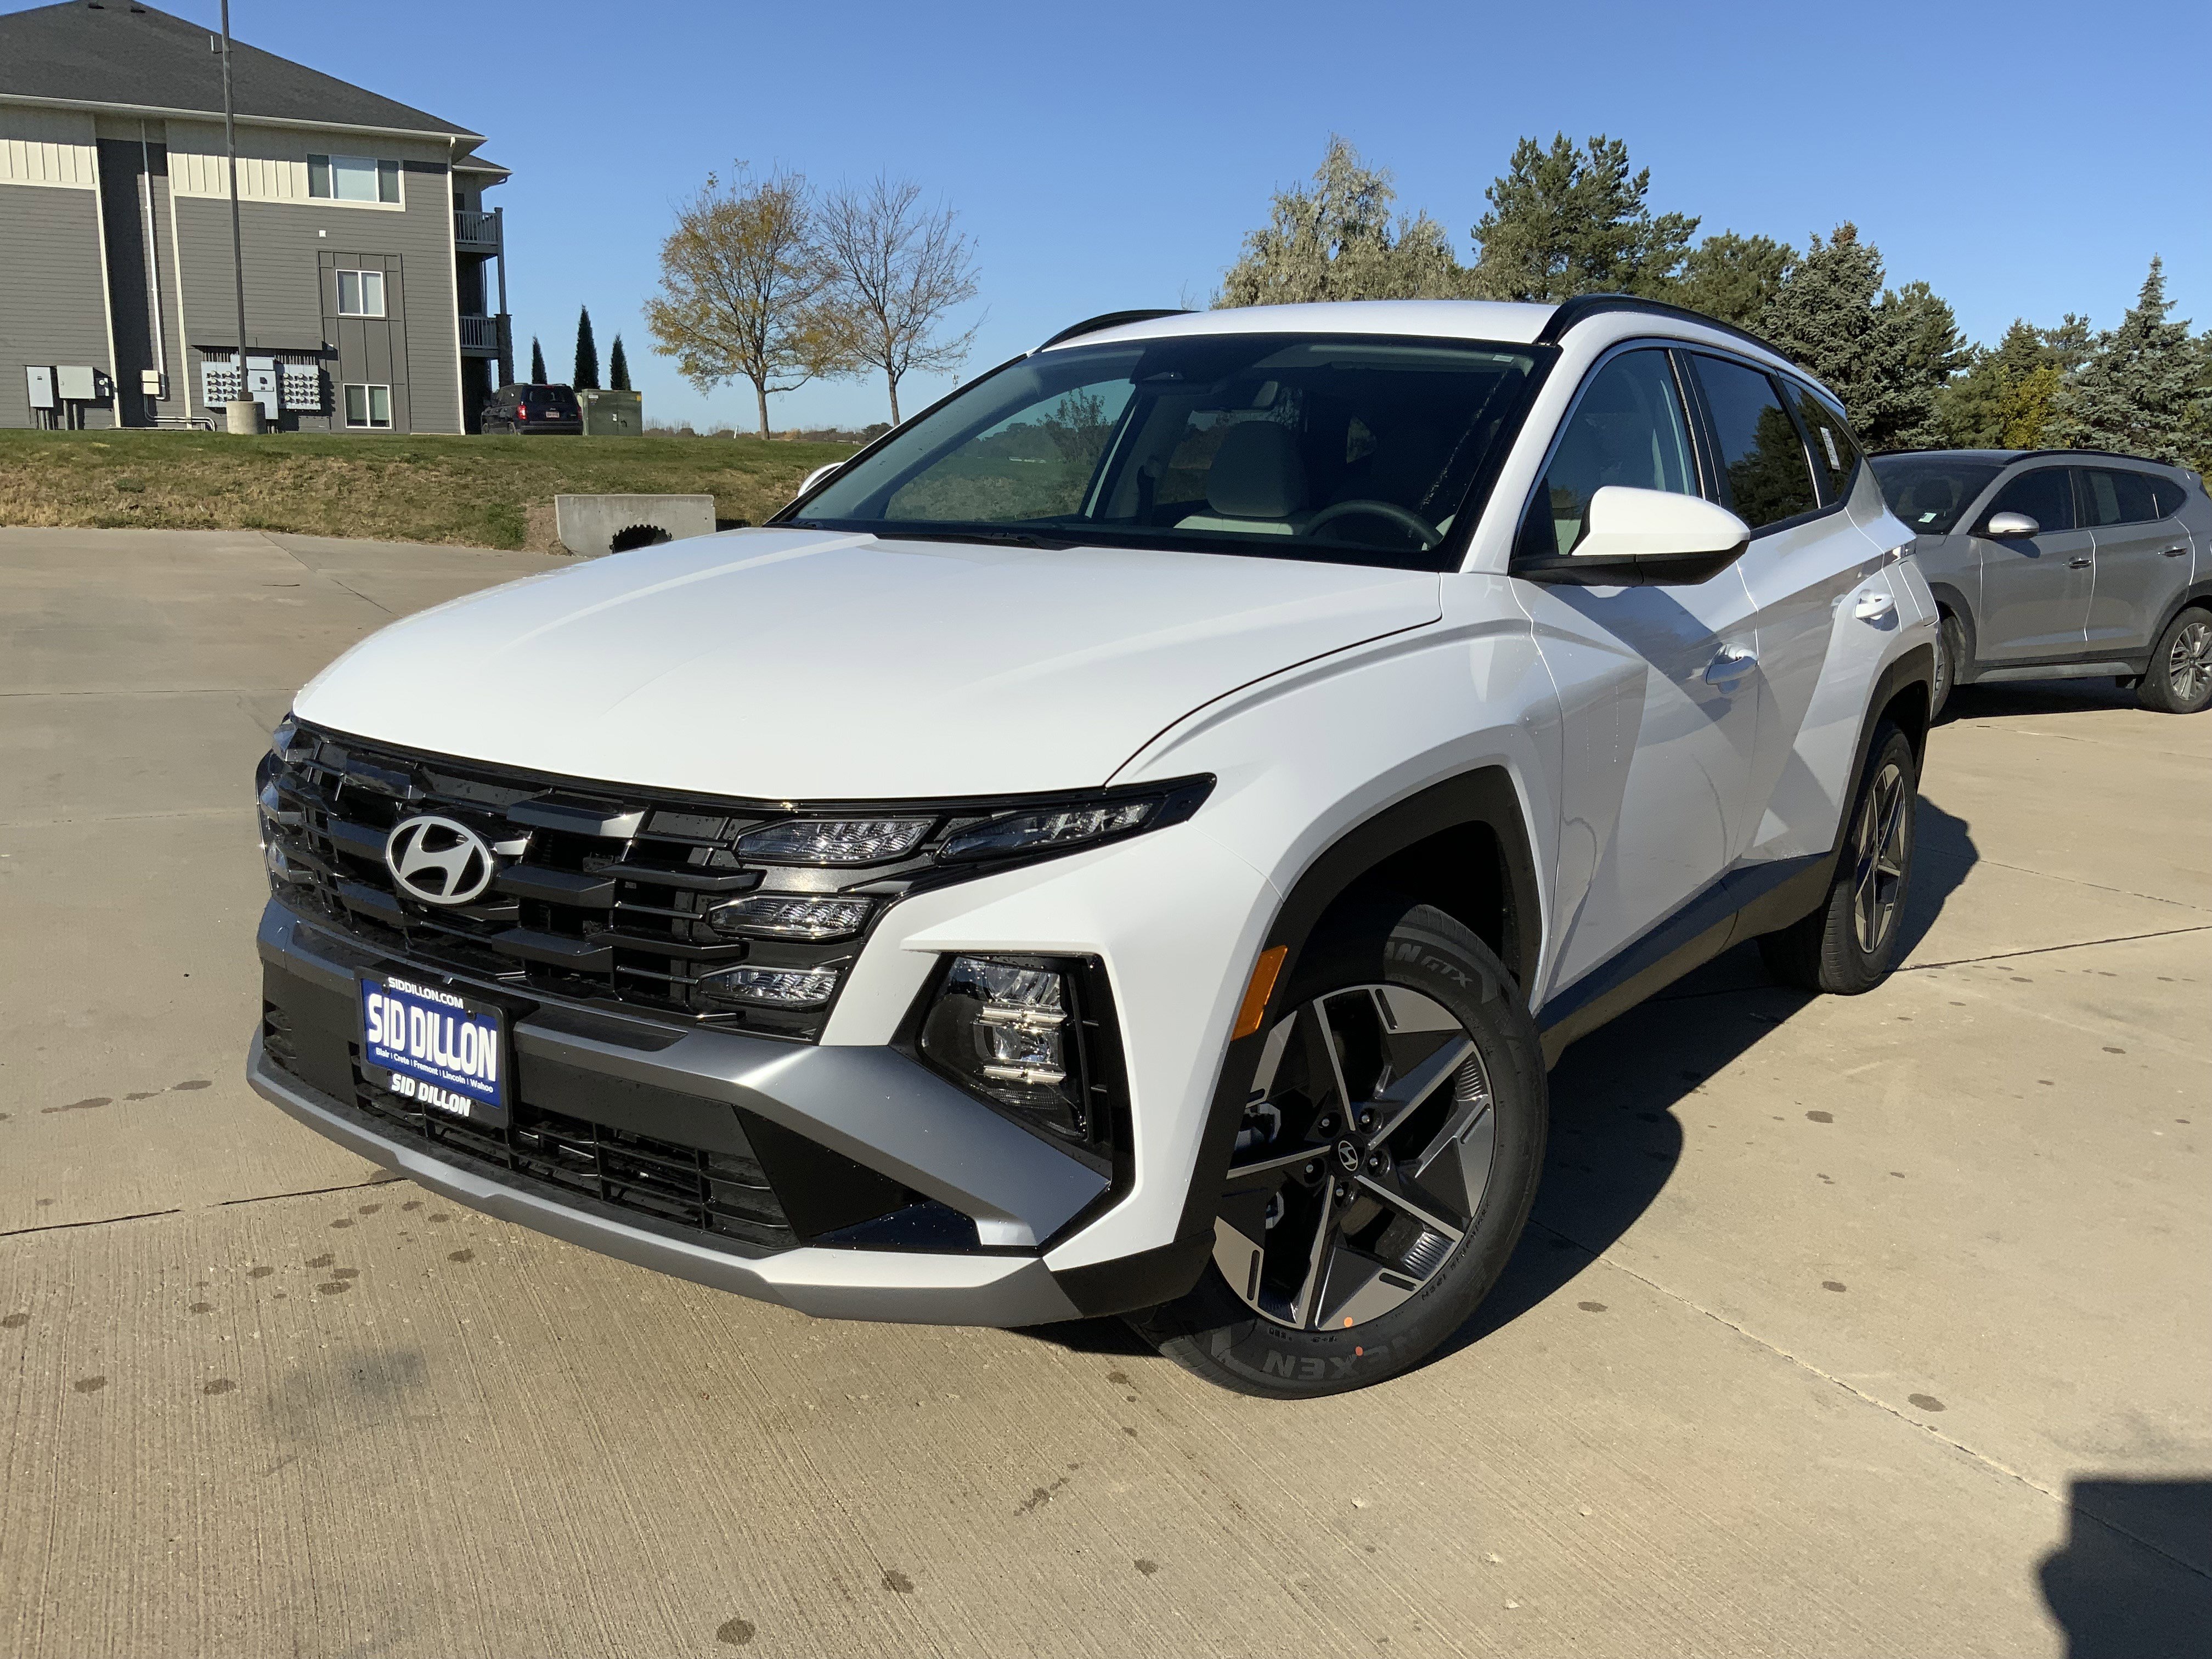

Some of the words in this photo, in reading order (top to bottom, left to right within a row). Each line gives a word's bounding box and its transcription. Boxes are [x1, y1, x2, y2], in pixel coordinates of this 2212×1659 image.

[388, 977, 464, 1009] SIDDILLON.COM
[1418, 955, 1472, 989] GTX
[369, 993, 405, 1051] SID
[411, 1006, 497, 1081] DILLON
[376, 1047, 390, 1058] Blair
[394, 1053, 410, 1065] Crete
[414, 1059, 438, 1076] Fremont
[442, 1070, 465, 1085] Lincoln
[470, 1078, 493, 1093] Wahoo
[391, 1073, 415, 1097] SID
[418, 1082, 471, 1117] DILLON
